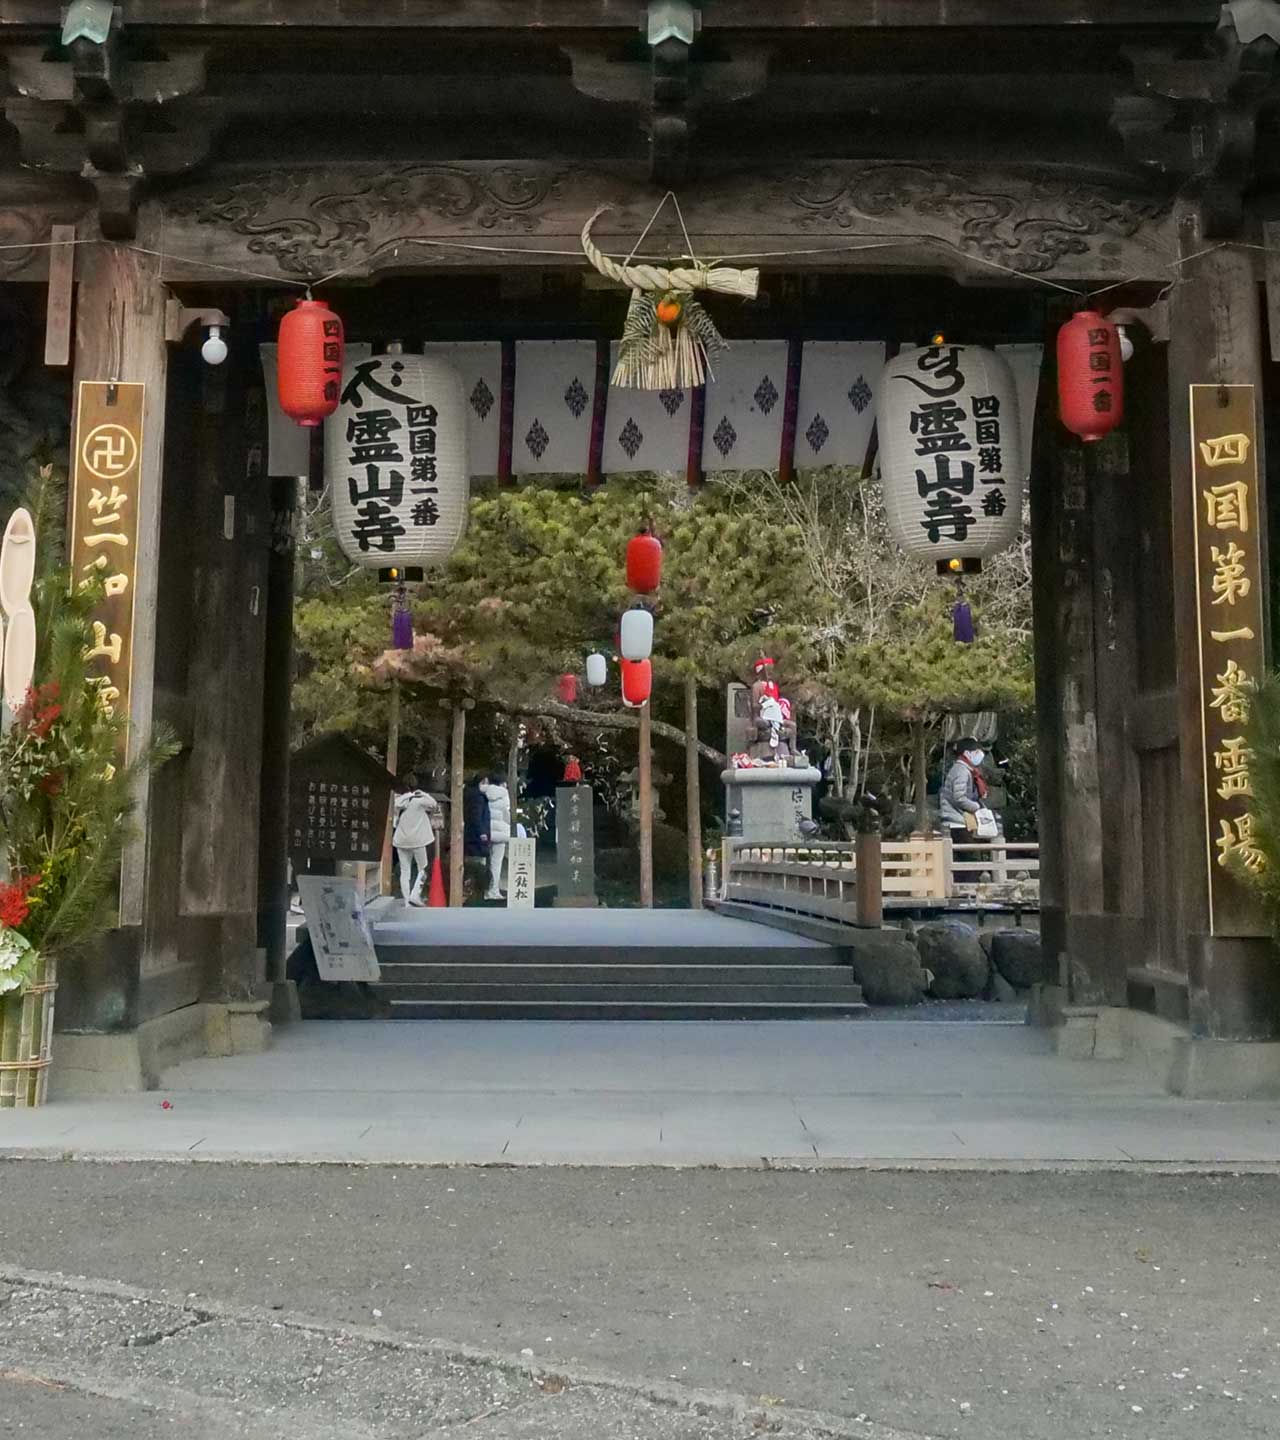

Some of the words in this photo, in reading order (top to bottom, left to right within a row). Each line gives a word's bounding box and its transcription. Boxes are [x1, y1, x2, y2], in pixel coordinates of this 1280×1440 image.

[322, 319, 341, 403] 四国一番
[1088, 328, 1113, 412] 四国一番
[346, 408, 407, 553] 霊山寺
[405, 404, 441, 526] 四国第一番
[909, 399, 977, 543] 霊山寺
[970, 394, 1007, 517] 四国第一番
[1199, 432, 1267, 874] 四国第一番霊場
